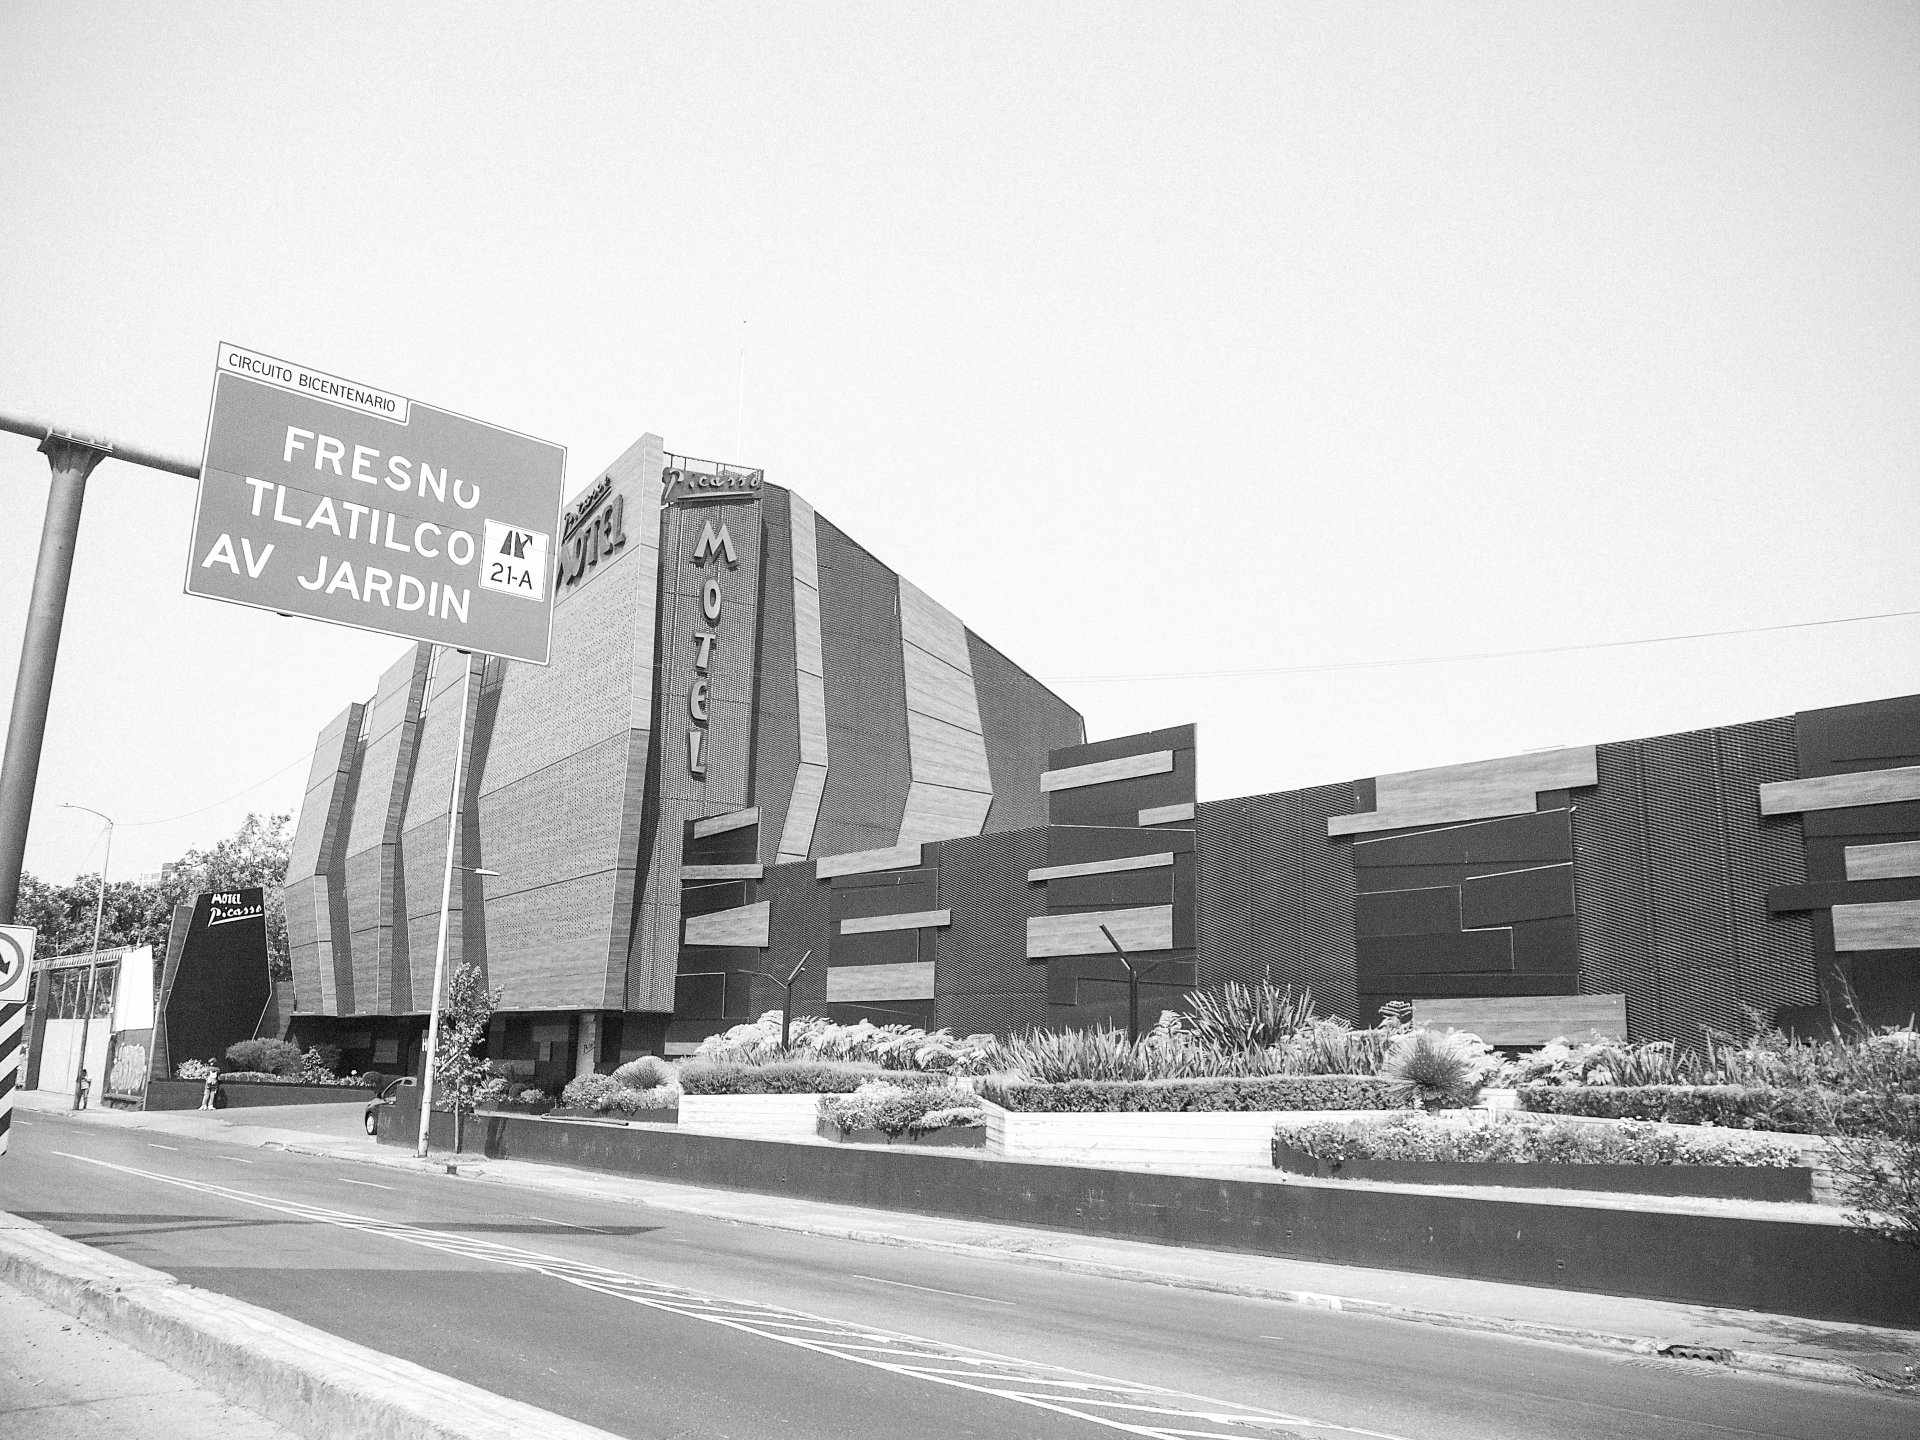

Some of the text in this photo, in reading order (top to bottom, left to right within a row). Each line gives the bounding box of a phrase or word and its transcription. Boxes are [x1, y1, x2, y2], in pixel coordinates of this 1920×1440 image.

[229, 353, 395, 412] CIRCUITO BICENTENARIO
[284, 425, 480, 510] FRESNO
[662, 468, 762, 500] Picasso
[245, 476, 475, 566] TLATILCO
[201, 533, 470, 624] AV JARDIN
[490, 562, 533, 590] 21-A
[688, 519, 739, 778] MOTEL
[207, 904, 263, 927] Picasso
[211, 893, 242, 904] MOTEL
